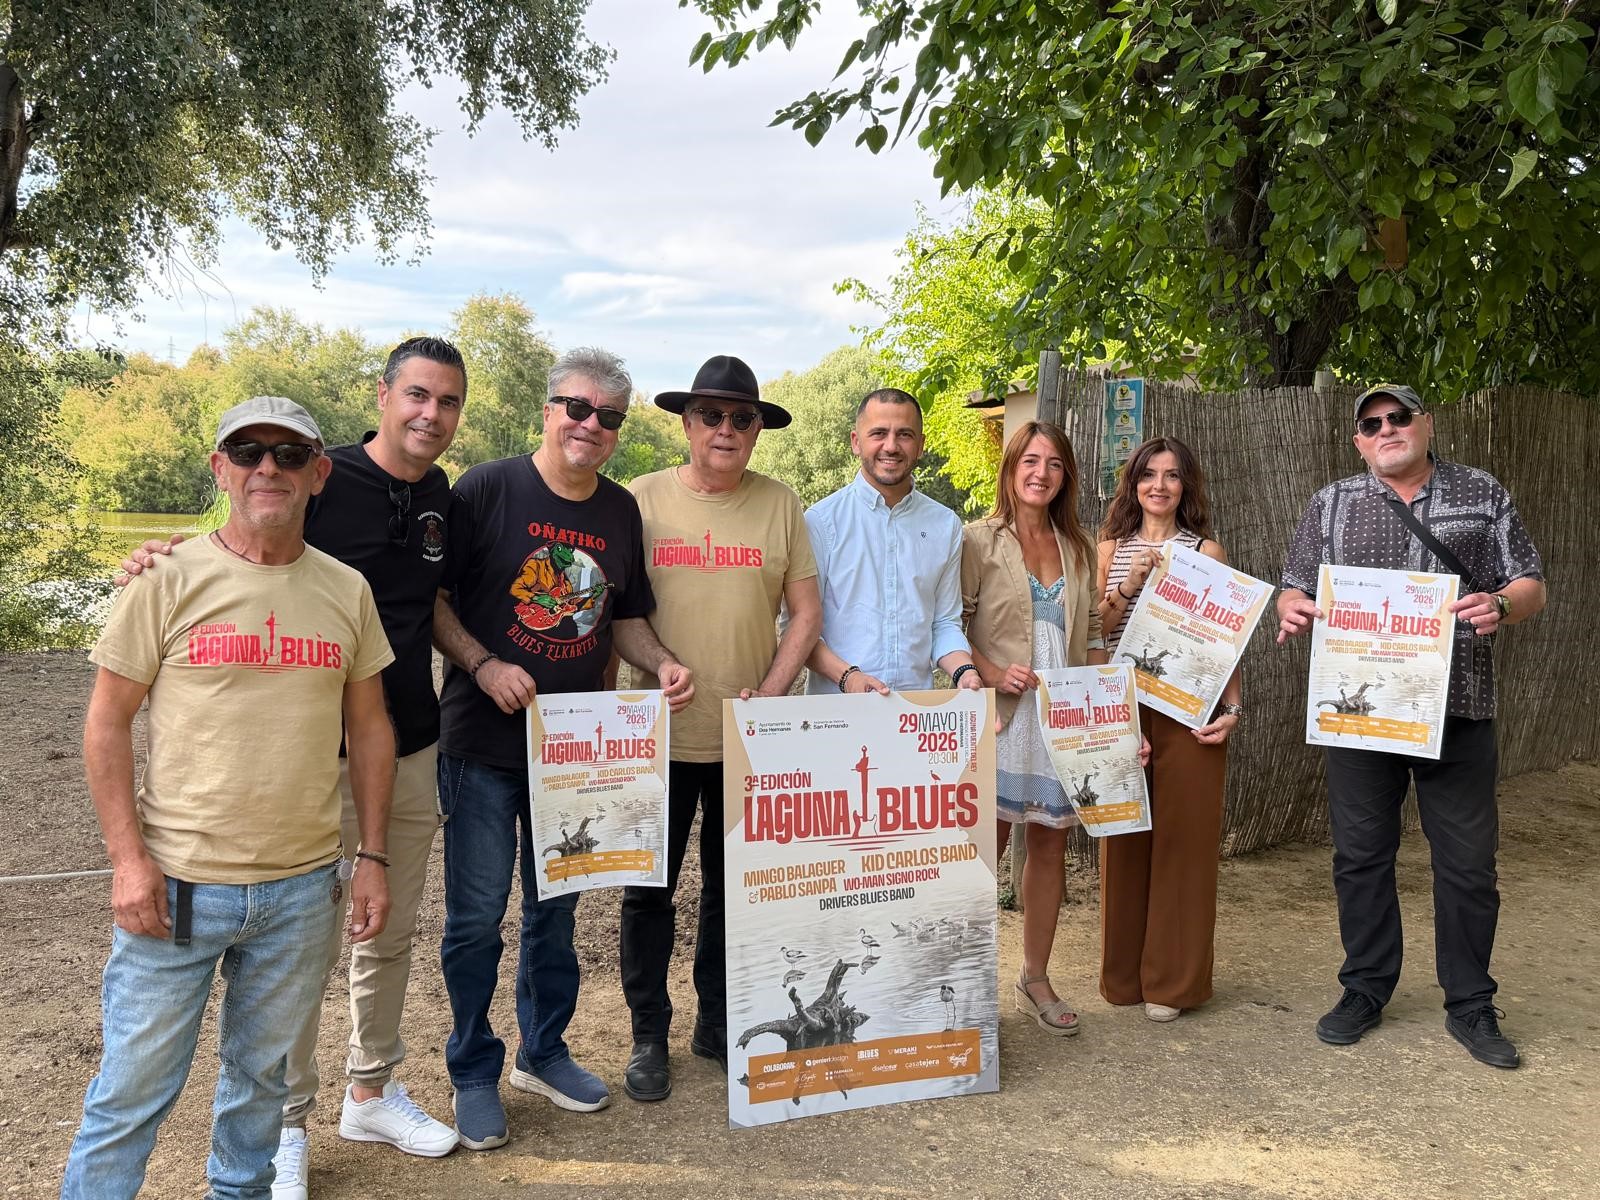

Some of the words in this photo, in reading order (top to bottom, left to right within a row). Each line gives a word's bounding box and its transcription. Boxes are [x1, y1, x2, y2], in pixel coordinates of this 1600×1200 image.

[528, 522, 606, 552] OÑATIKO
[653, 546, 701, 568] LAGUNA
[714, 546, 762, 567] BLUES
[1154, 578, 1197, 611] LAGUNA
[1202, 600, 1245, 633] BLUES
[200, 622, 236, 635] EDICIÓN
[1328, 608, 1377, 631] LAGUNA
[1391, 614, 1441, 638] BLUES
[188, 635, 261, 666] LAGUNA
[280, 636, 341, 669] BLUES
[506, 623, 544, 655] BLUES
[545, 633, 598, 662] ELKARTEA
[626, 714, 646, 724] 2026
[1048, 707, 1085, 729] LAGUNA
[1093, 704, 1131, 724] BLUES
[549, 730, 574, 741] EDICIÓN
[918, 732, 957, 752] 2026
[541, 741, 593, 765] LAGUNA
[605, 738, 656, 760] BLUES
[609, 767, 636, 777] CARLOS
[760, 768, 811, 791] EDICIÓN
[744, 789, 851, 844] LAGUNA
[877, 782, 978, 832] BLUES
[861, 852, 885, 873] KID
[886, 847, 939, 870] CARLOS
[940, 842, 978, 864] BAND
[744, 866, 785, 888] MINGO
[787, 859, 845, 884] BALAGUER
[843, 875, 885, 891] WO-MAN
[886, 870, 914, 886] SIGNO
[915, 867, 940, 882] ROCK
[760, 882, 797, 903] PABLO
[798, 877, 837, 897] SANPA
[819, 894, 859, 911] DRIVERS
[860, 890, 889, 906] BLUES
[889, 887, 915, 902] BAND
[894, 1046, 917, 1054] MERAKI
[904, 1058, 940, 1069] casatejera
